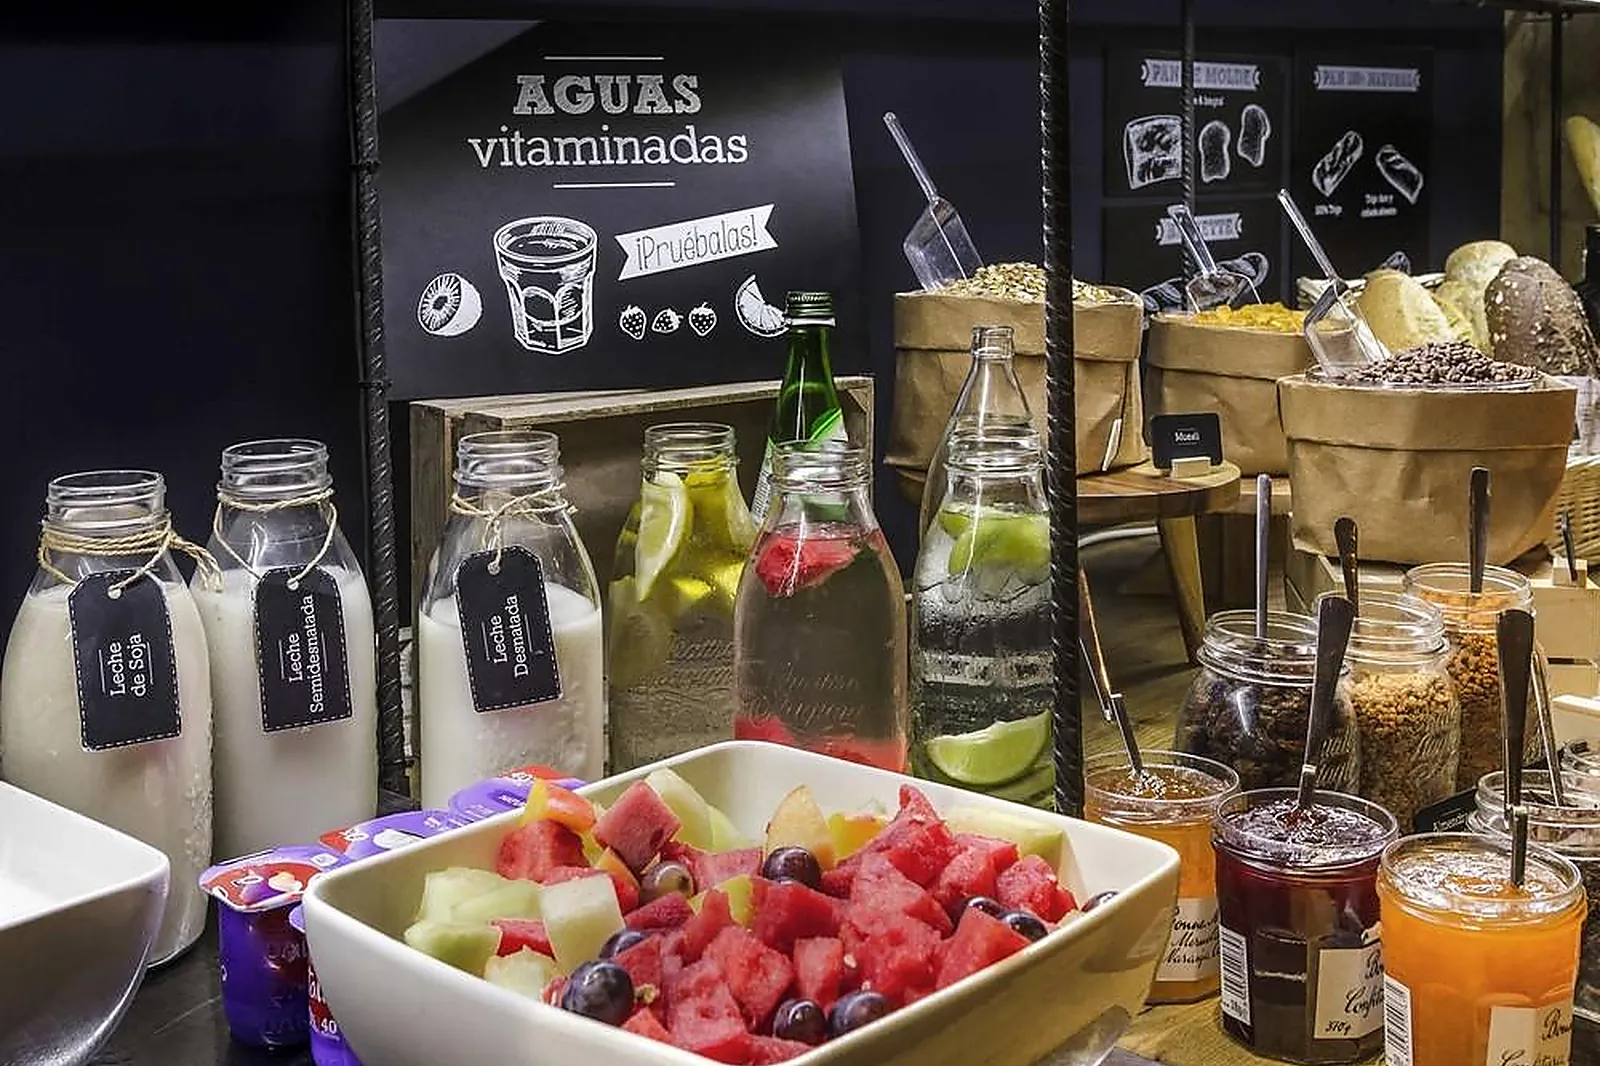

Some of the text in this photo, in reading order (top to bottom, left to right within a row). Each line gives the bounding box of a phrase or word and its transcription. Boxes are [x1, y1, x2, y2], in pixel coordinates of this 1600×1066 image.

[512, 74, 702, 115] AGUAS
[467, 124, 749, 168] vitaminadas
[636, 214, 758, 271] ¡Pruébalas!
[286, 632, 304, 683] Leche
[300, 594, 324, 713] Semidesnatada
[489, 615, 508, 664] Leche
[504, 594, 529, 678] Desnatada
[107, 641, 126, 697] Leche
[127, 633, 147, 697] de Soja
